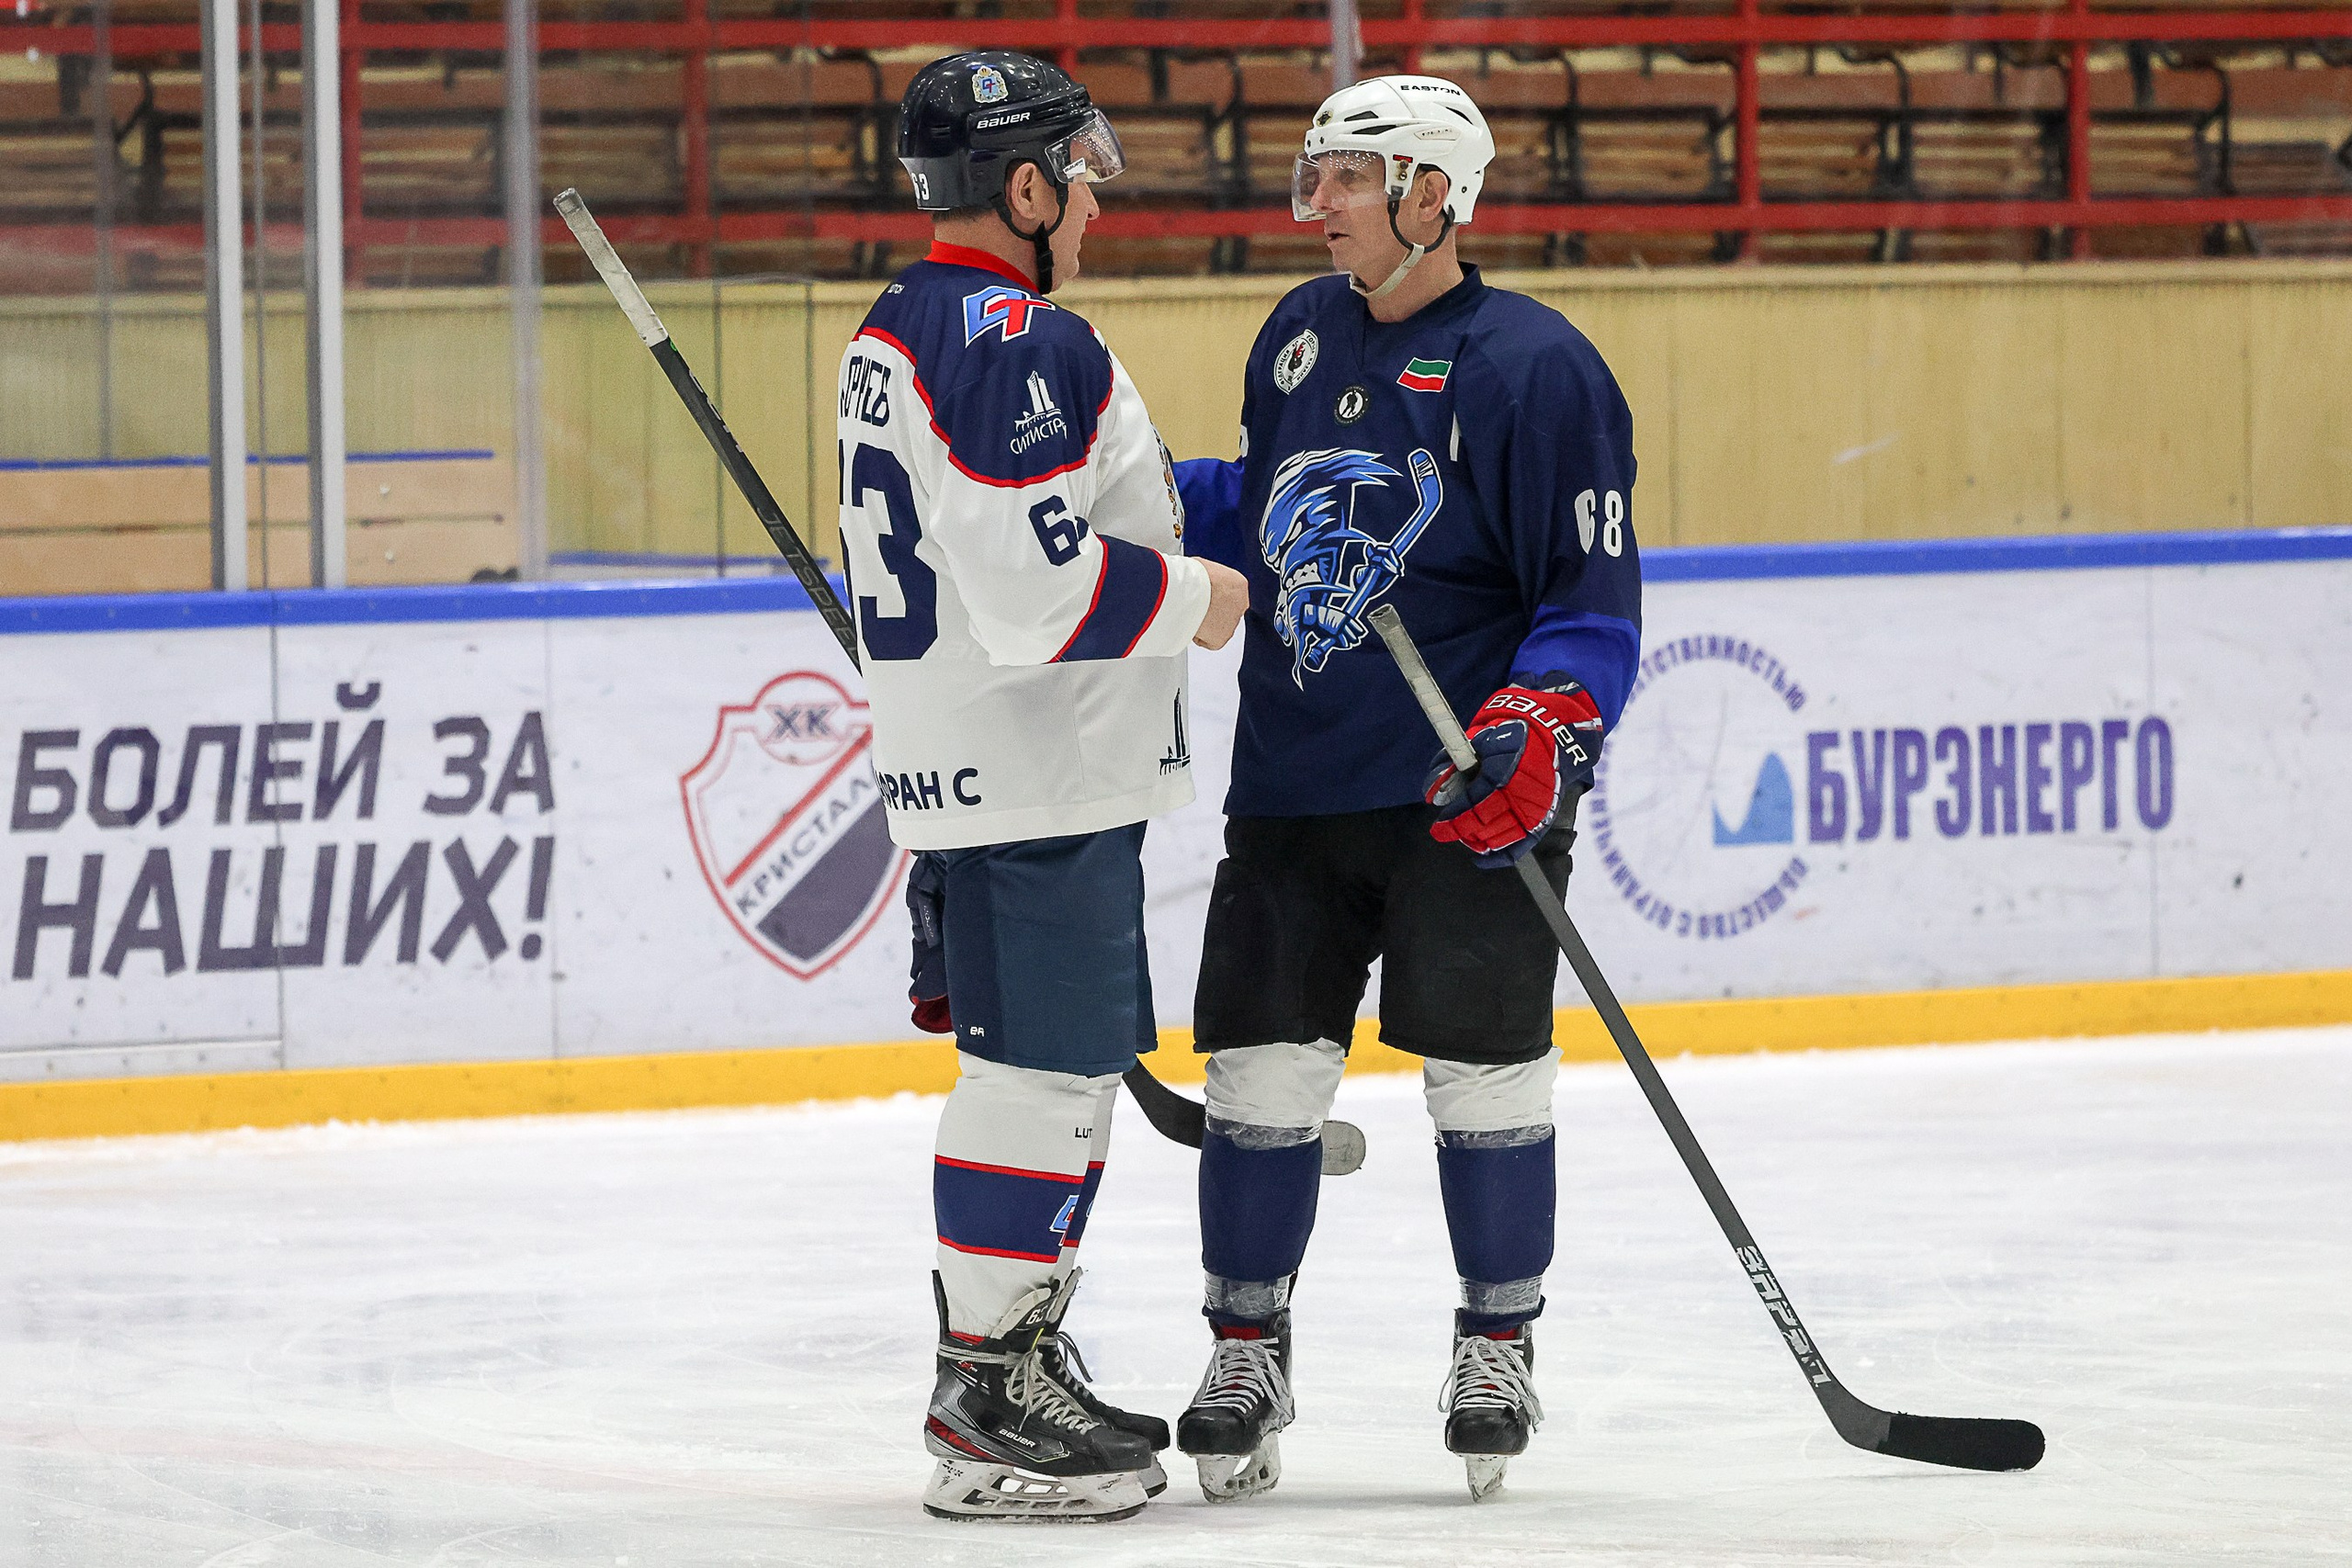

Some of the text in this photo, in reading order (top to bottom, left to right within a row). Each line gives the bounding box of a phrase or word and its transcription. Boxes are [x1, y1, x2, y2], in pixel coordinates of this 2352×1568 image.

[977, 111, 1031, 130] BAUER
[1400, 85, 1461, 96] EASTON
[1028, 495, 1090, 567] 6
[1574, 489, 1624, 558] 68
[10, 682, 556, 831] БОЛЕЙ ЗА
[771, 704, 832, 740] ХК
[1485, 694, 1589, 767] BAUER
[1806, 715, 2175, 845] БУРЭНЕРГО
[735, 776, 873, 919] КРИСТАЛ
[12, 834, 556, 980] НАШИХ!
[998, 1427, 1036, 1449] BAUER
